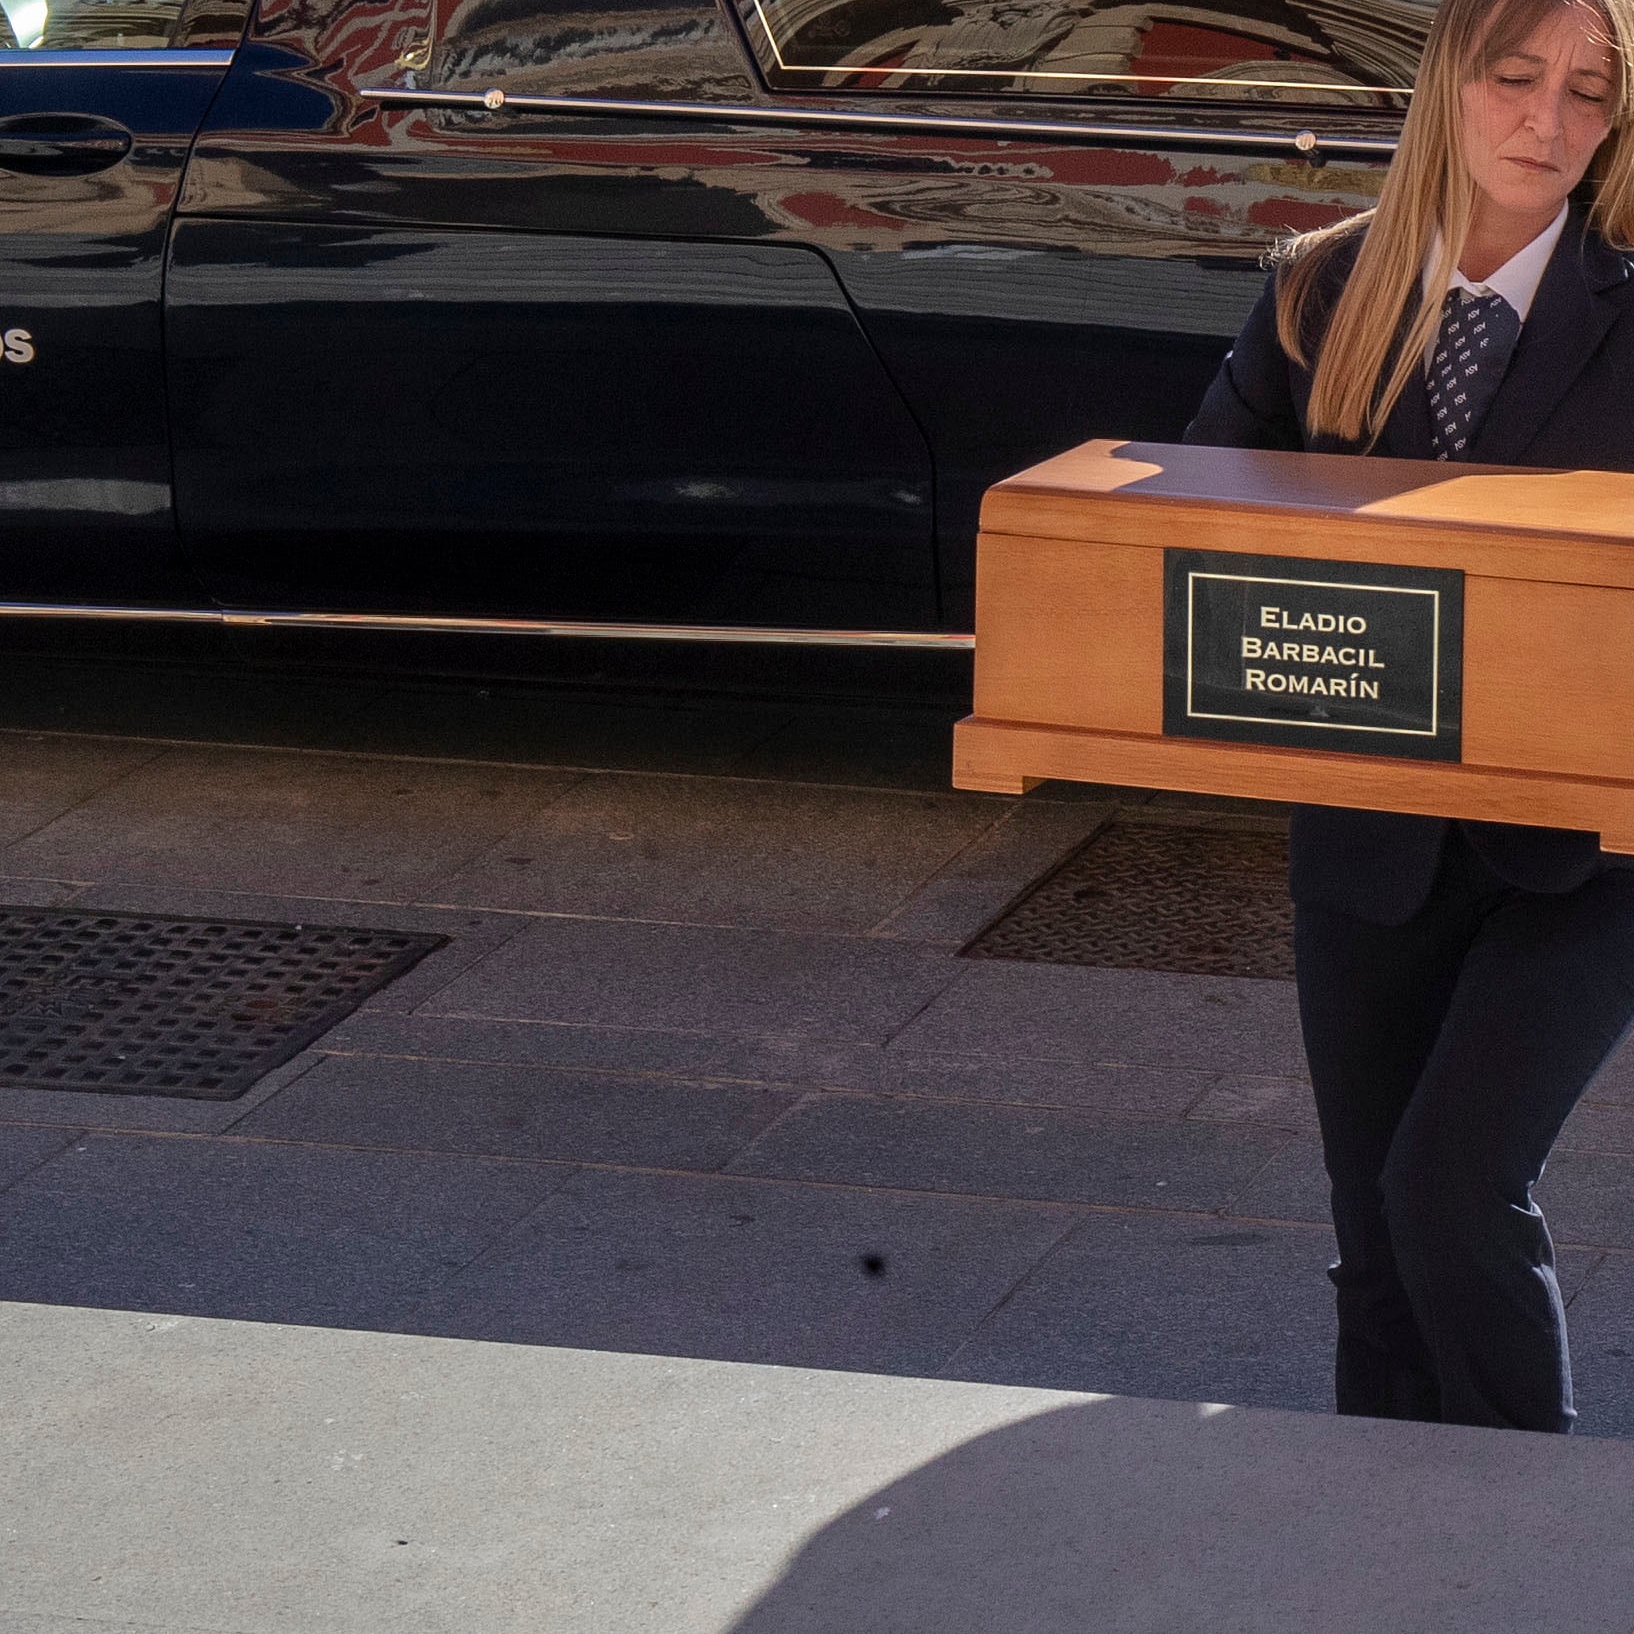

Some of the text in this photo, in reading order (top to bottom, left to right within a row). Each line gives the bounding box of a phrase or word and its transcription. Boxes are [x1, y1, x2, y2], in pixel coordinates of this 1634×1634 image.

[1260, 606, 1367, 634] ELADIO
[1241, 636, 1385, 668] BARBACIL
[1245, 668, 1379, 700] ROMARÍN
